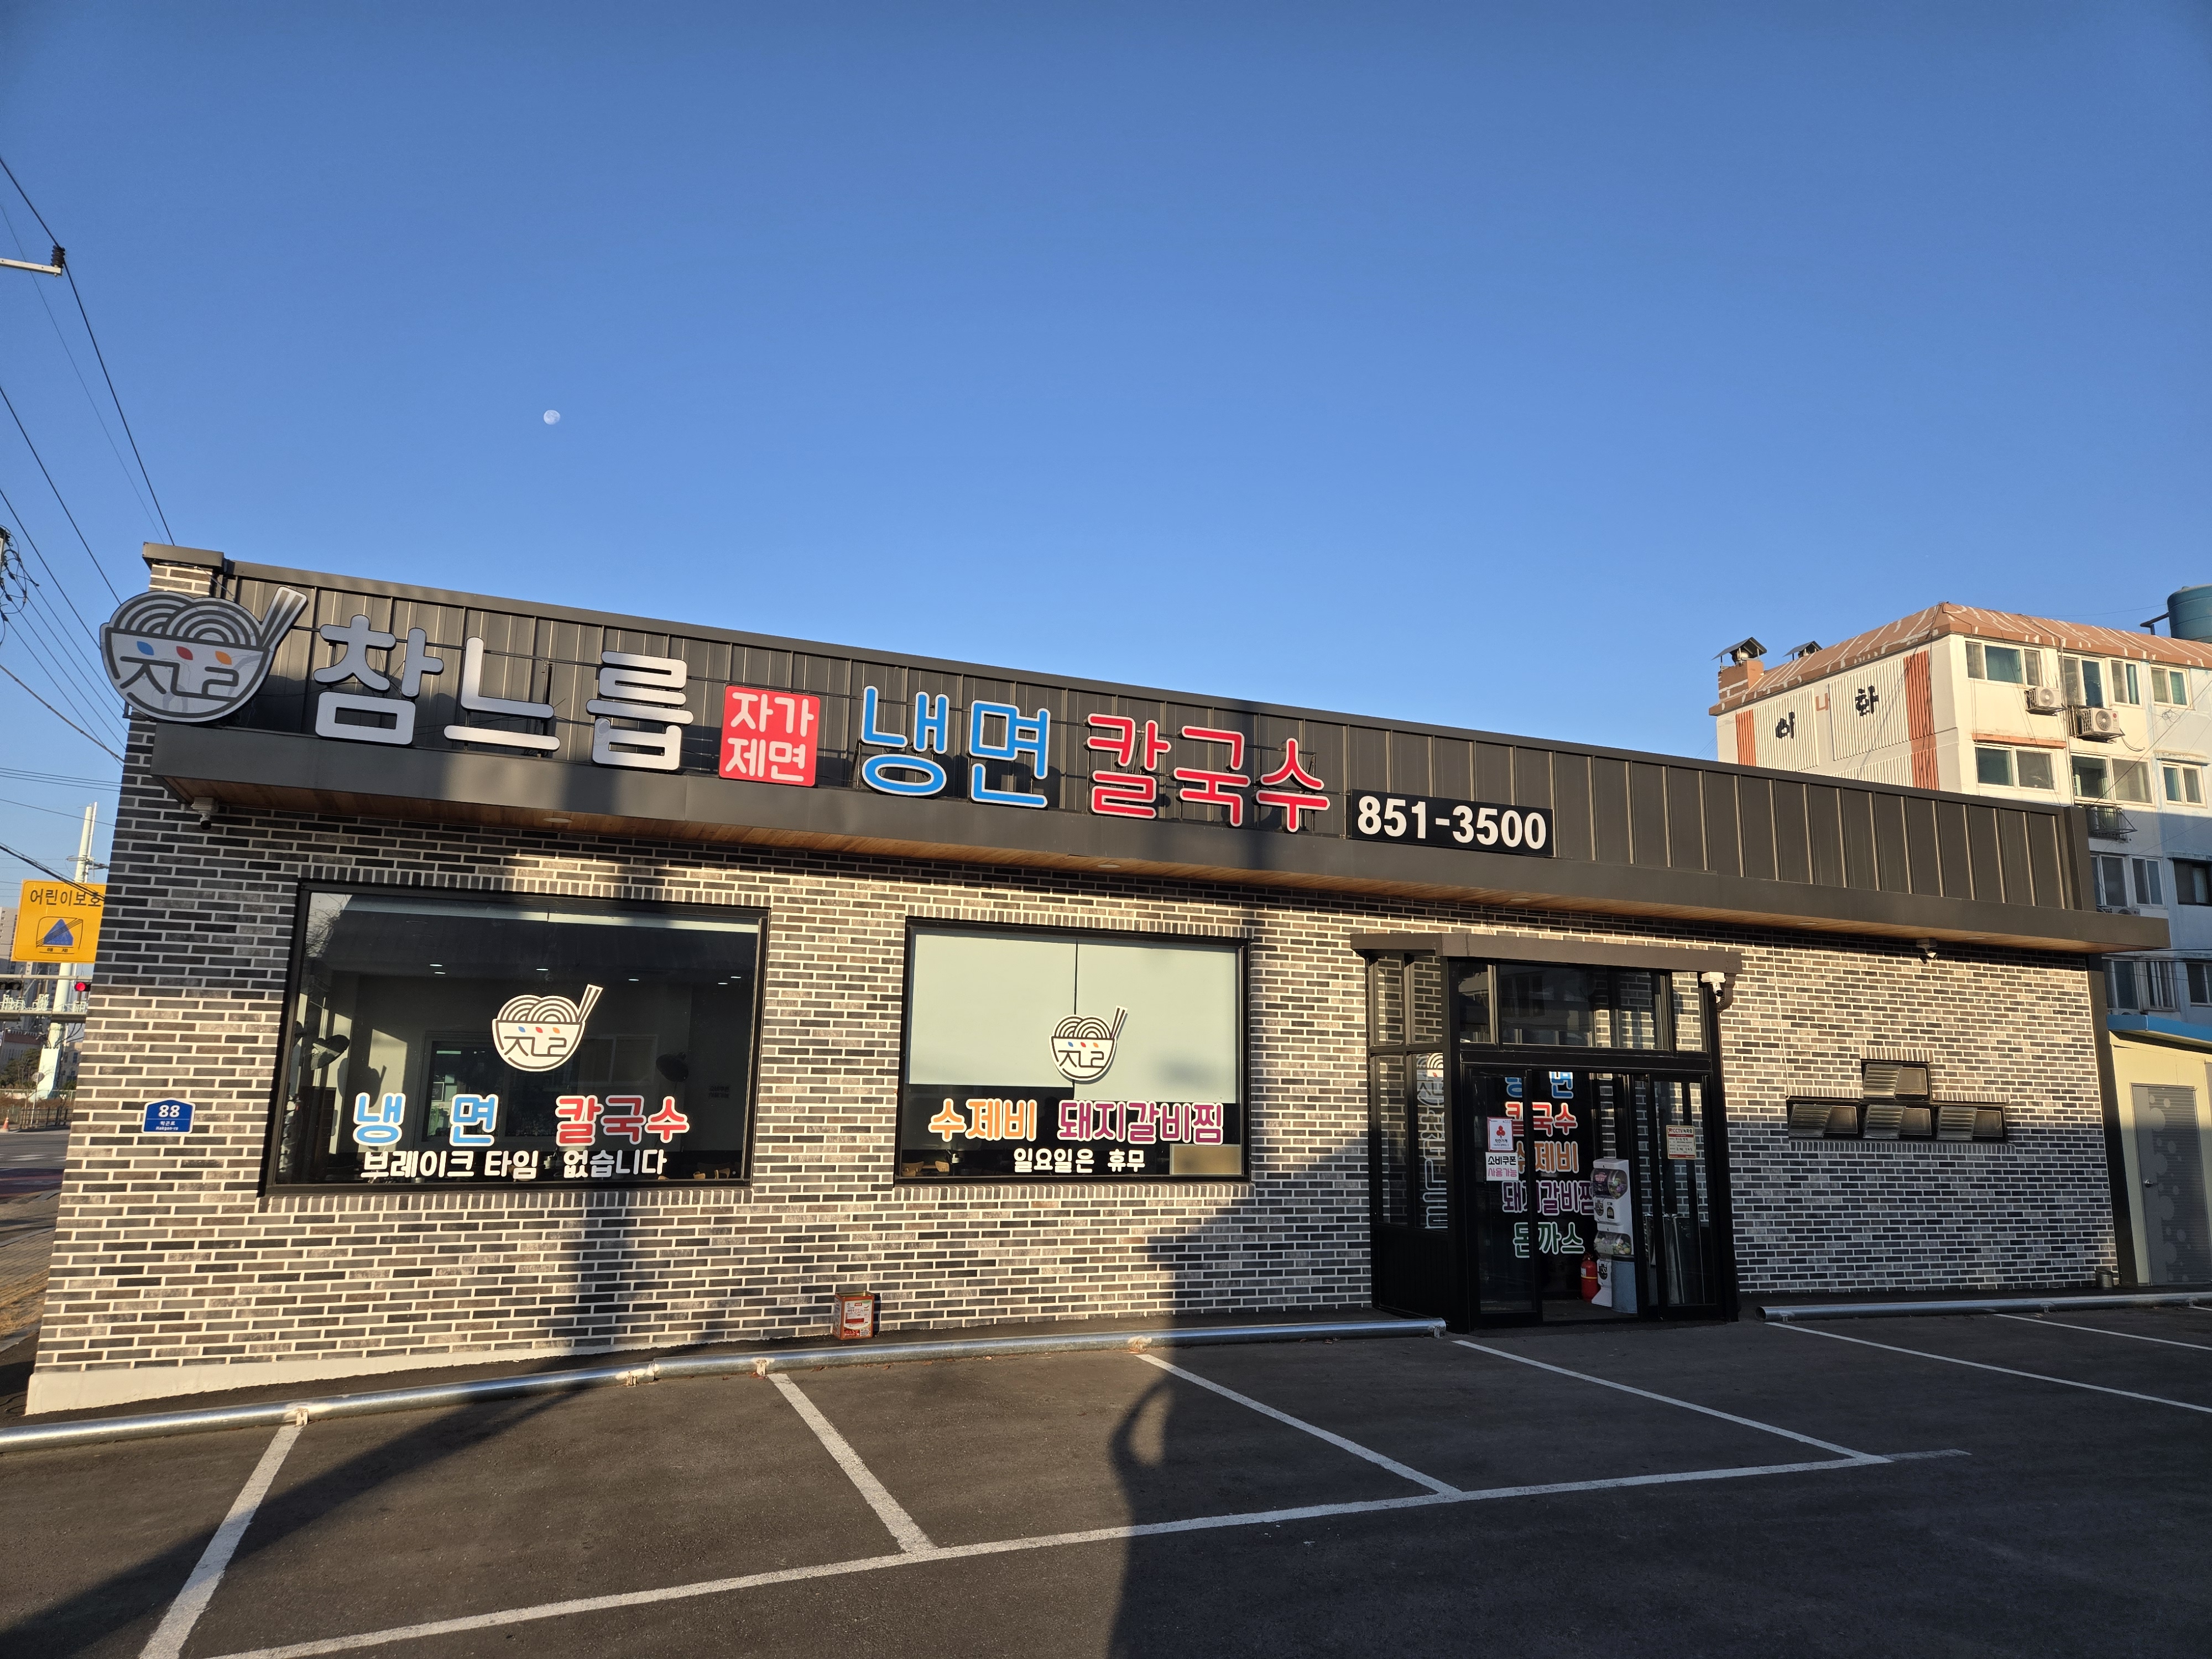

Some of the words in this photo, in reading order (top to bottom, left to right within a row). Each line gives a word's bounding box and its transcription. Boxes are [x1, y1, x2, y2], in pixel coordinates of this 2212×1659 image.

[314, 614, 693, 771] 참느릅
[729, 692, 814, 738] 자가
[1776, 712, 1795, 739] 이
[1855, 685, 1879, 716] 화
[725, 737, 806, 782] 제면
[860, 685, 1050, 808] 냉면
[1086, 713, 1329, 832] 칼국수
[1358, 796, 1546, 849] 851-3500
[159, 1105, 180, 1117] 88
[555, 1094, 690, 1147] 칼국수
[928, 1098, 1037, 1142] 수제비
[1057, 1099, 1224, 1145] 돼지갈비찜
[361, 1150, 474, 1178] 브레이크
[484, 1150, 538, 1180] 타임
[564, 1149, 667, 1179] 없습니다
[1014, 1148, 1094, 1173] 일요일은
[1108, 1149, 1145, 1172] 휴무
[1488, 1156, 1516, 1165] 소비쿠폰
[1488, 1168, 1517, 1177] 사용가능
